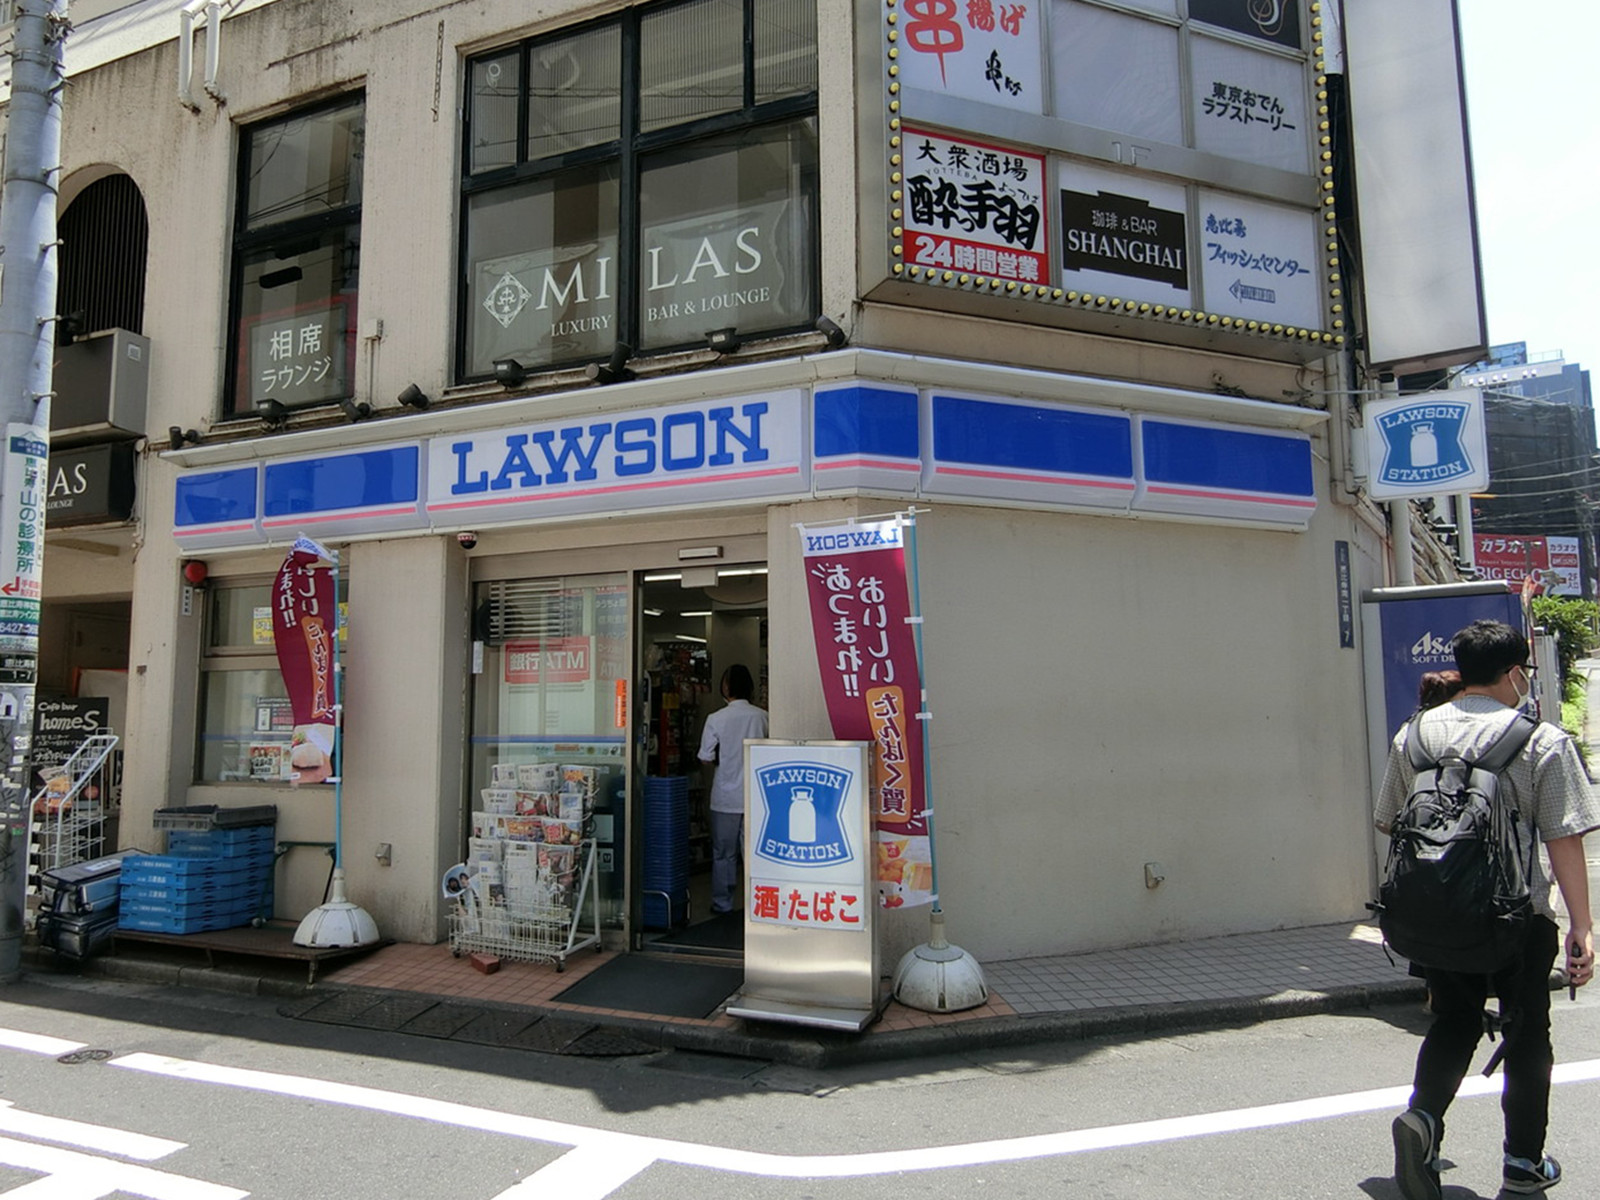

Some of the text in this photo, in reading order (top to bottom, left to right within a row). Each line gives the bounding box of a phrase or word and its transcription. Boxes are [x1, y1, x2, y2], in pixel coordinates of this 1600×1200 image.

[1202, 97, 1296, 132] ラブストーリー
[1212, 82, 1284, 115] 東京おでん
[916, 139, 1028, 182] 大衆酒場
[906, 174, 1040, 251] 酔っ手羽
[1092, 209, 1118, 231] 珈琲
[1130, 216, 1158, 237] BAR
[915, 235, 1040, 282] 24時間営業
[1068, 229, 1183, 271] SHANGHAI
[1207, 242, 1311, 277] フィッシュセンター
[550, 286, 771, 338] LUXURY BAR & LOUNGE
[269, 323, 323, 362] 相席
[261, 355, 332, 393] ラウンジ
[1383, 406, 1462, 429] LAWSON
[451, 401, 769, 496] LAWSON
[1387, 460, 1463, 481] STATION
[1411, 631, 1456, 656] Asa
[1412, 655, 1439, 665] SOFT
[764, 768, 843, 790] LAWSON
[765, 838, 842, 861] STATION
